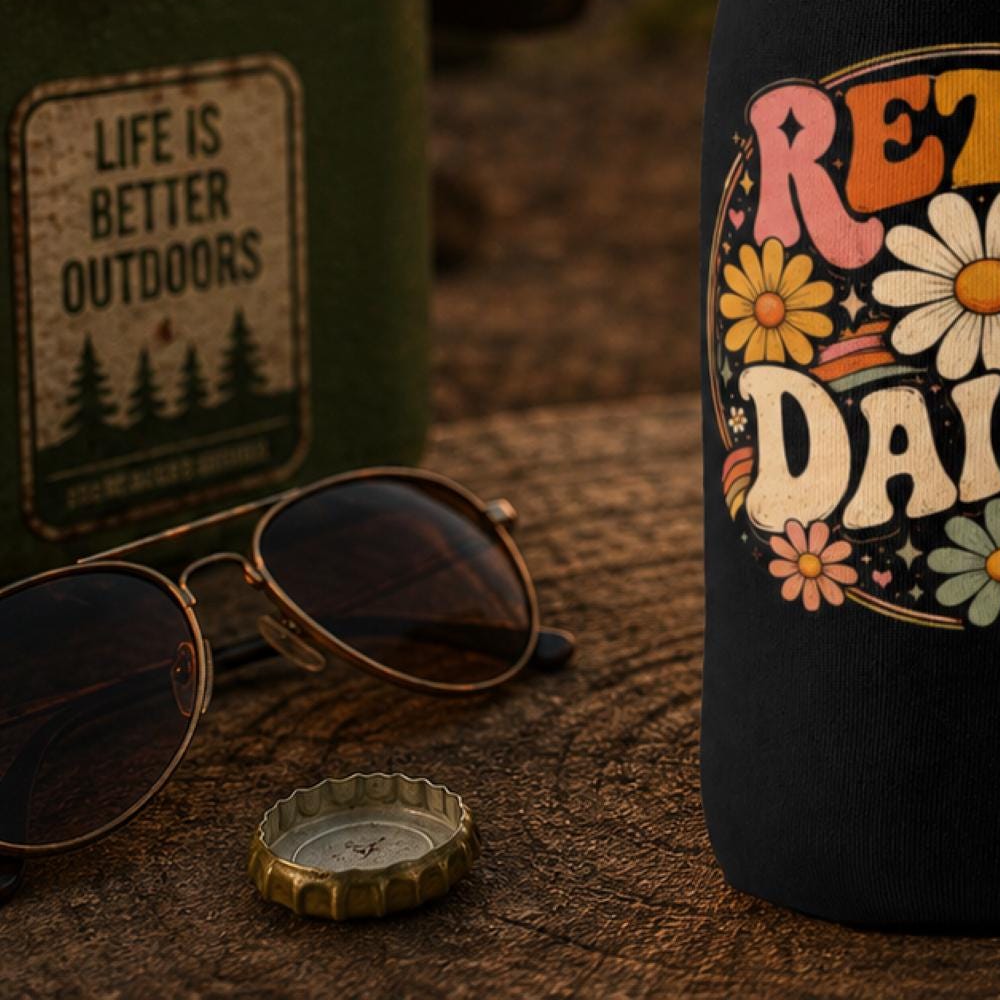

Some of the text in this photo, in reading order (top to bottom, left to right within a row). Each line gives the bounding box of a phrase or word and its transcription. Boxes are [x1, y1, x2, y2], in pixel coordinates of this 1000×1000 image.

[95, 101, 222, 173] LIFE IS
[90, 169, 230, 241] BETTER
[61, 228, 262, 315] OUTDOORS
